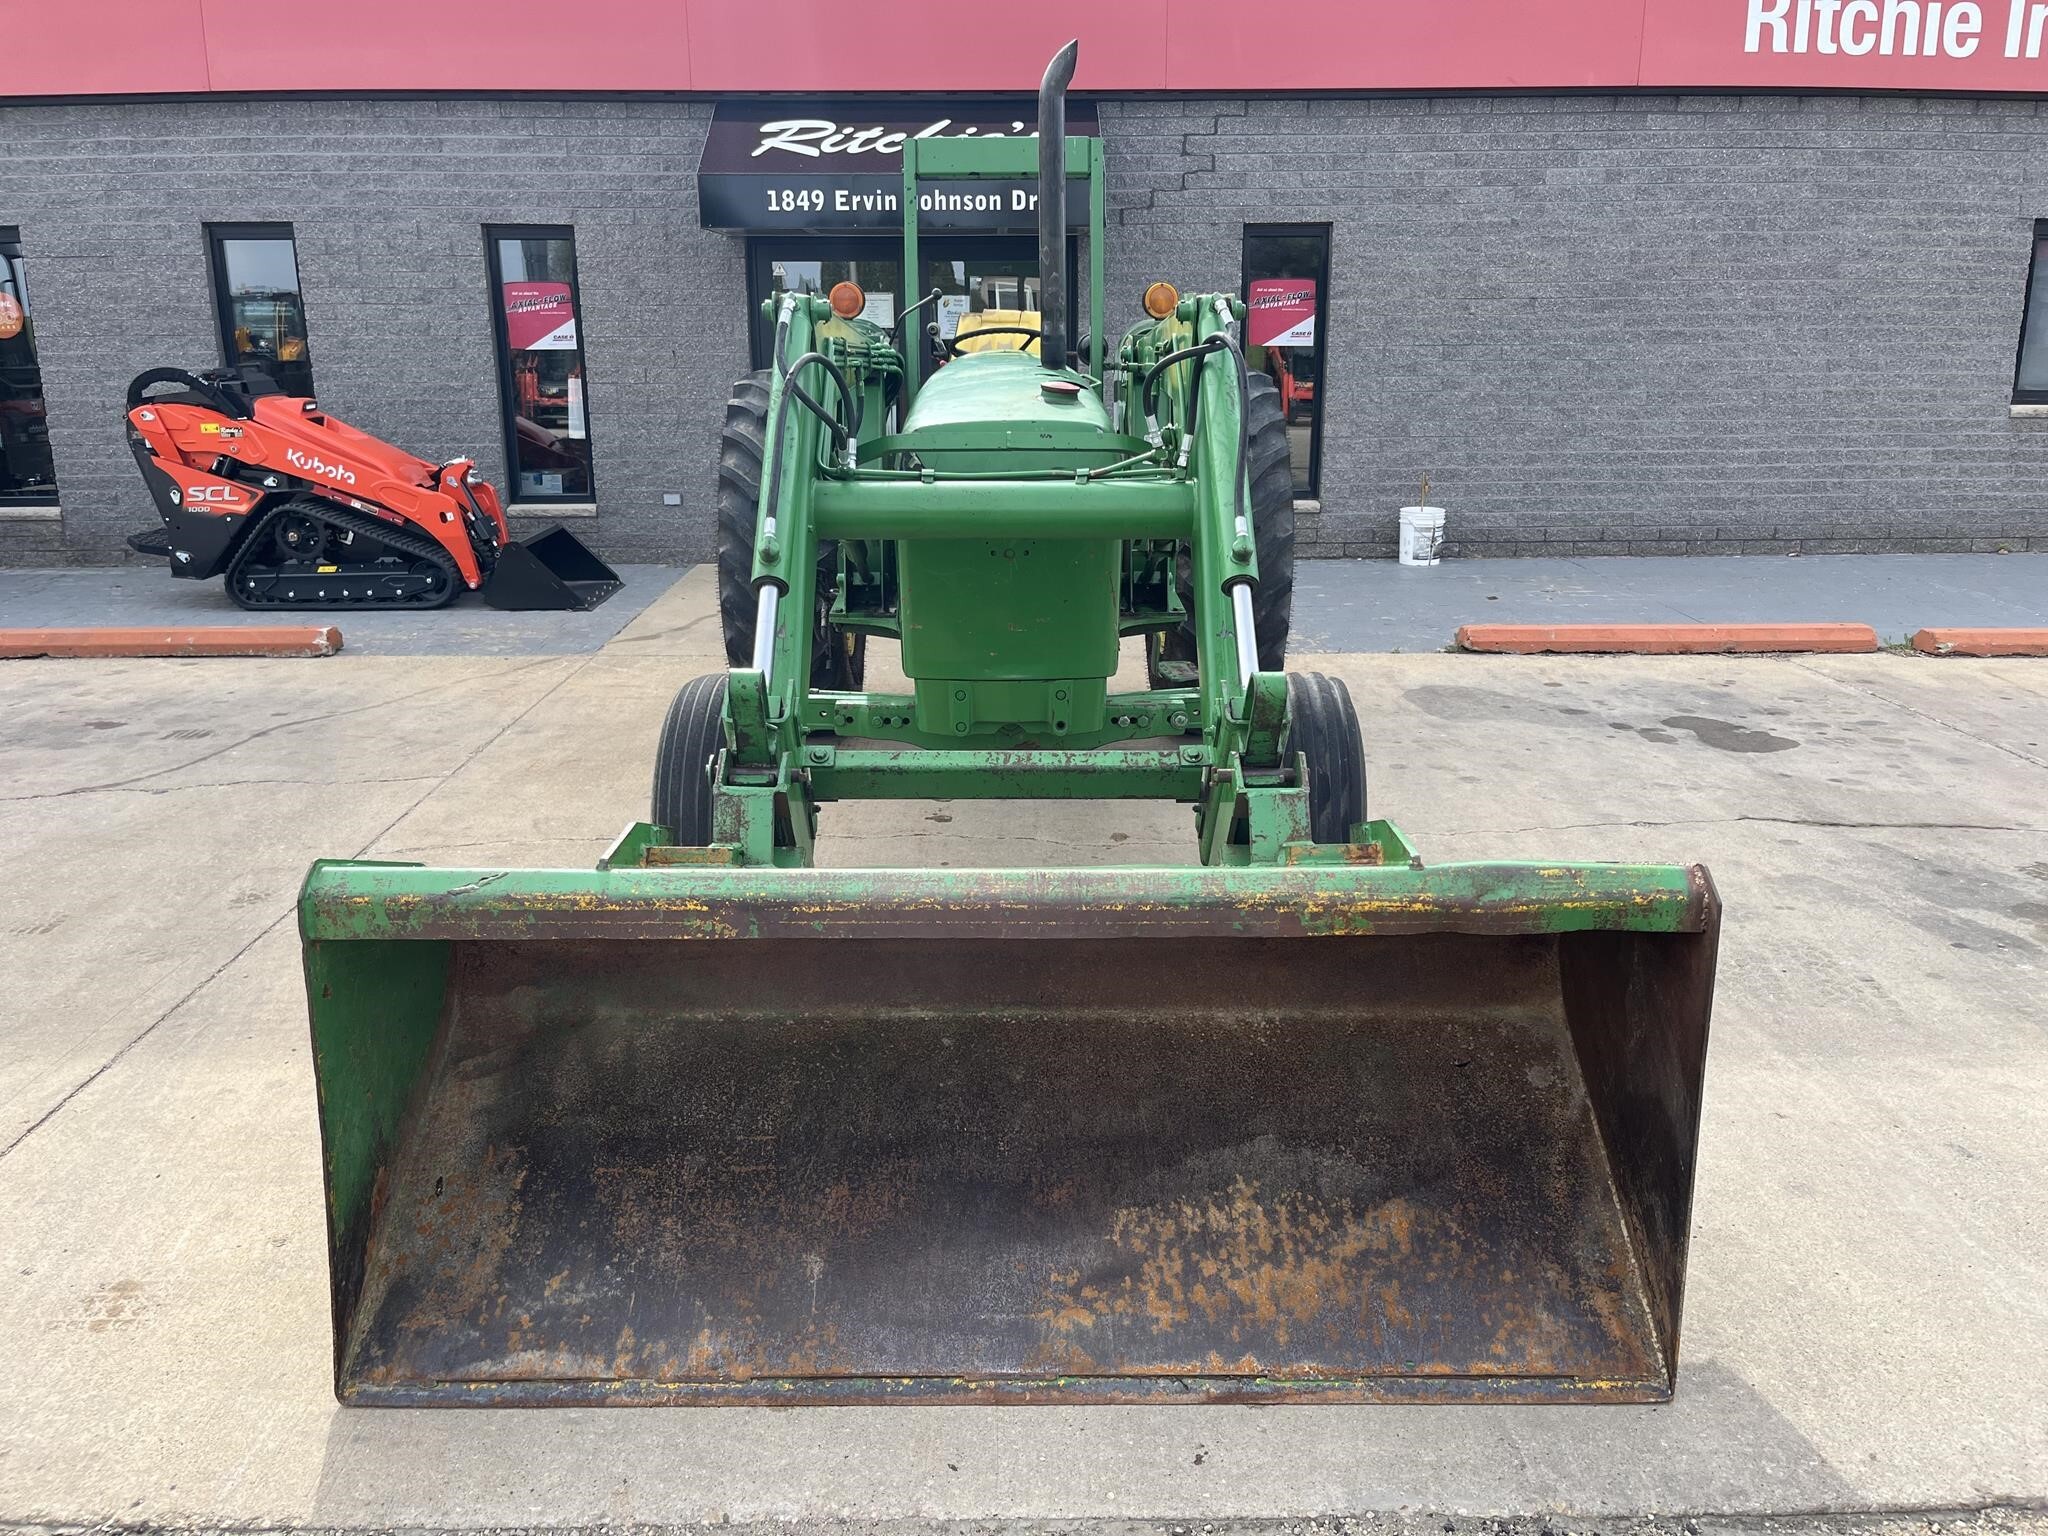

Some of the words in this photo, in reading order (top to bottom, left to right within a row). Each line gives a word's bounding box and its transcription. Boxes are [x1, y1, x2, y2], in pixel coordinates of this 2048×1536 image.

[1744, 0, 1982, 58] Ritchie
[751, 119, 1039, 157] Ritc'
[767, 189, 825, 212] 1849
[834, 189, 898, 212] Ervin
[916, 189, 1001, 212] ohnson
[518, 302, 558, 313] ADVANTAGE
[1260, 299, 1301, 309] ADVANTAGE
[287, 448, 356, 485] Kubota
[187, 486, 240, 502] SCL
